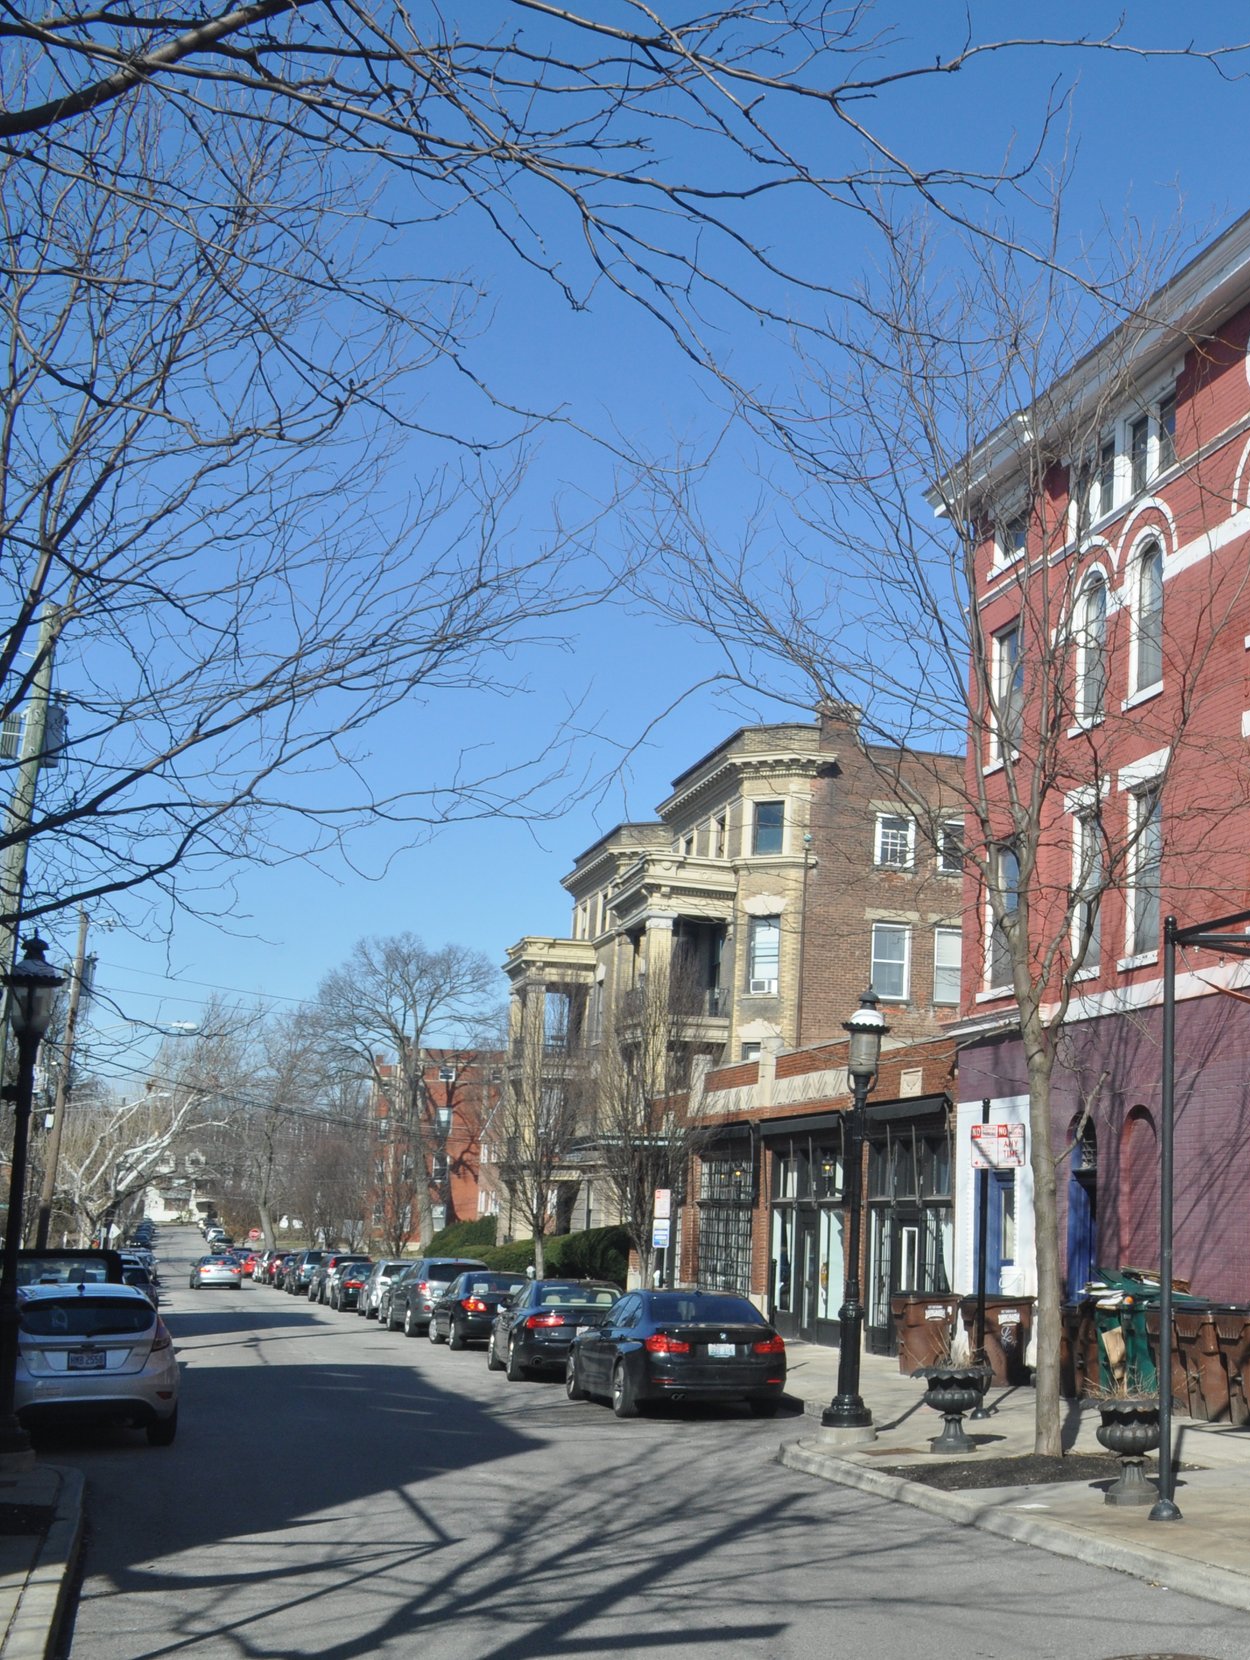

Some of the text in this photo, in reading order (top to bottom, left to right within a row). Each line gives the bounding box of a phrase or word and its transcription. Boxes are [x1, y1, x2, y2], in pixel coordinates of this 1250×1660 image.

[998, 1126, 1007, 1136] NO
[1003, 1140, 1018, 1148] ANY
[1003, 1150, 1018, 1158] TIME
